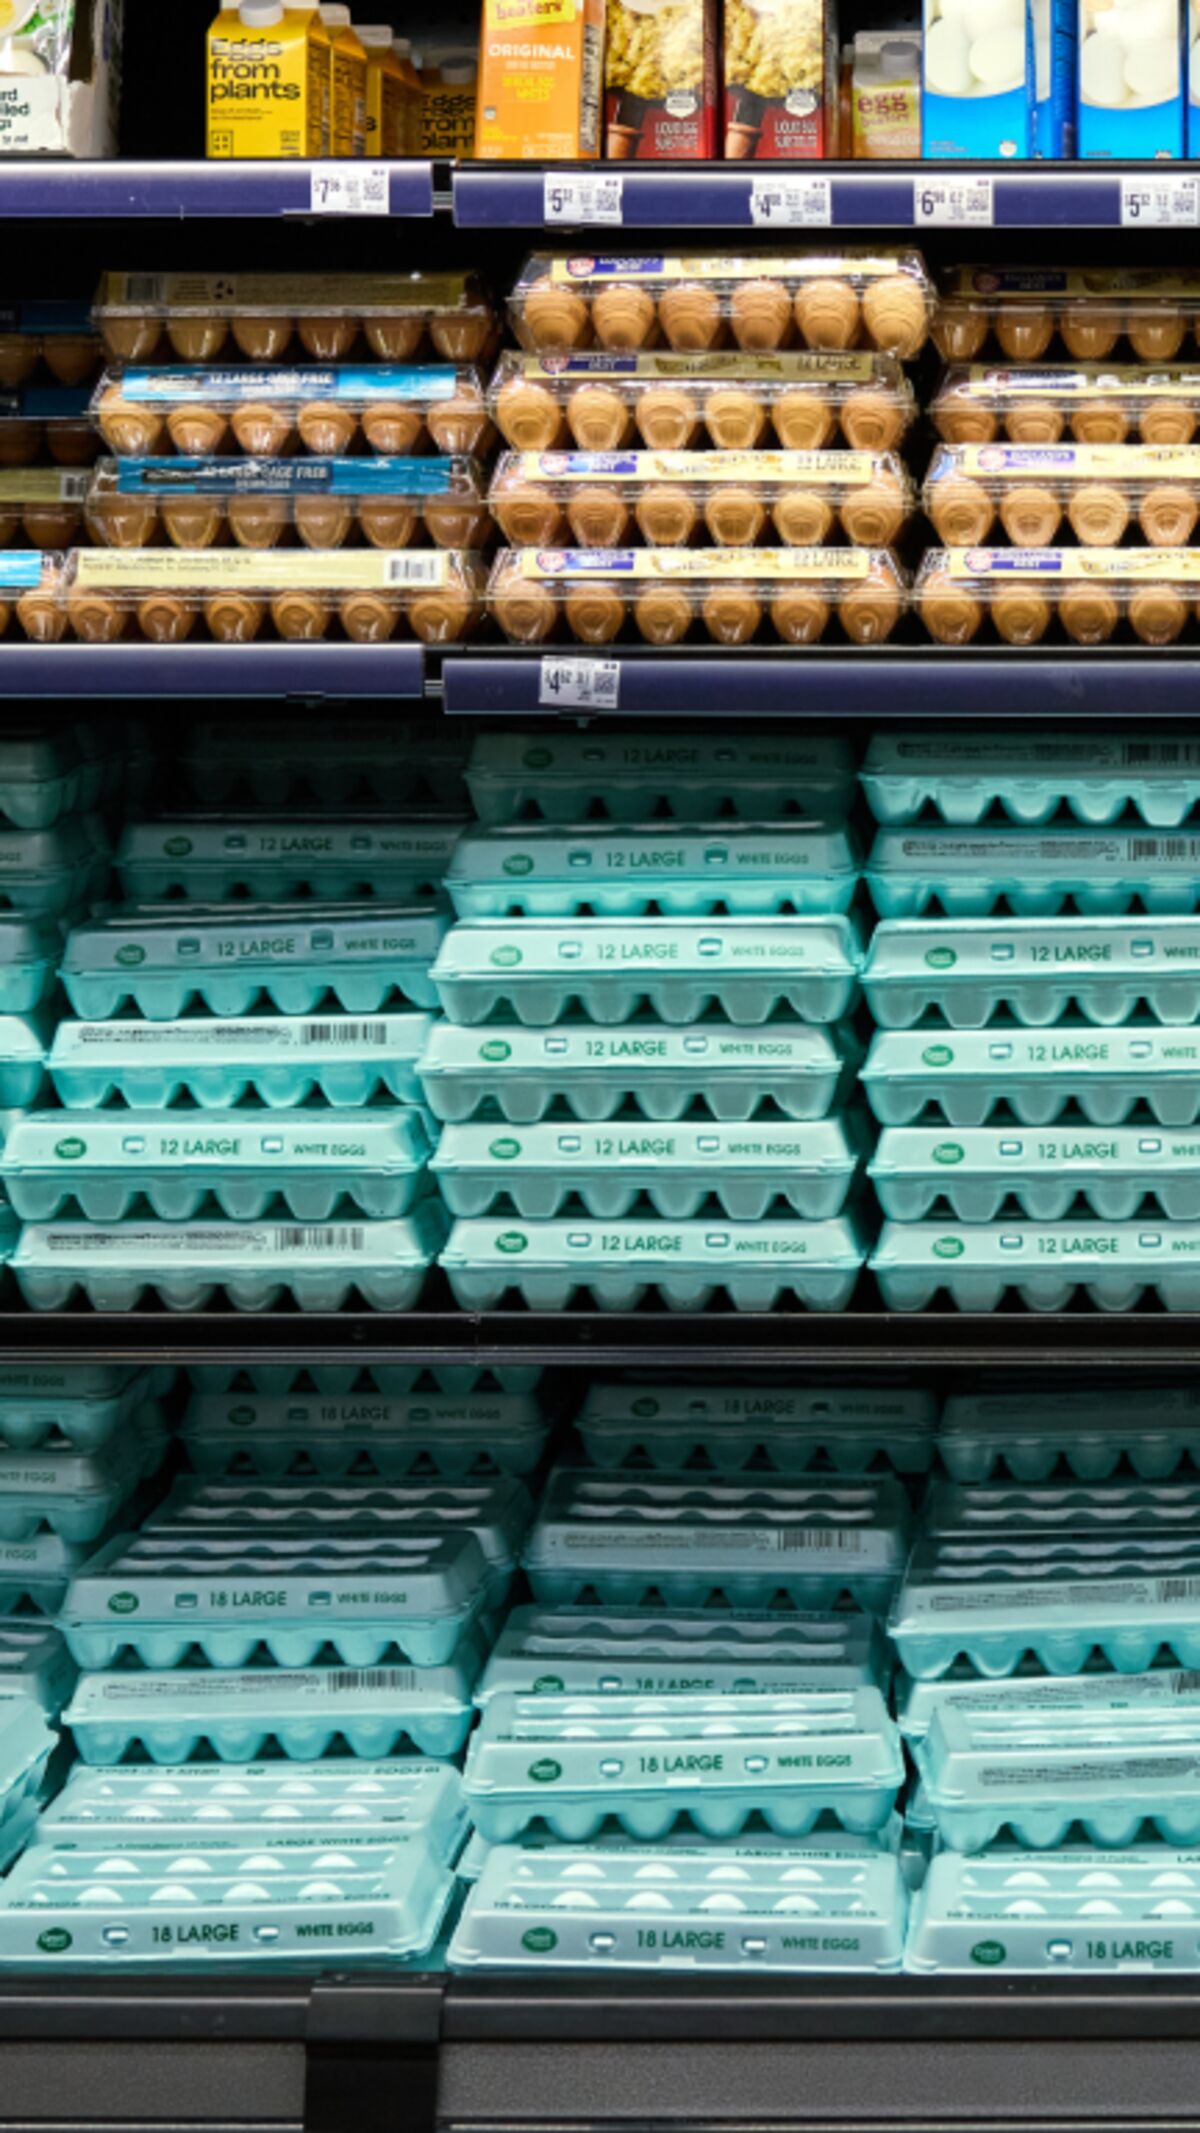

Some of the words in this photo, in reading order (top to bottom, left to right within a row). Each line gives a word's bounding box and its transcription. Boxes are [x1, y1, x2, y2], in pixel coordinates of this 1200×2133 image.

[210, 37, 283, 61] Eggs
[488, 43, 575, 60] ORIGINAL
[210, 58, 281, 79] from
[210, 80, 301, 104] plants
[857, 89, 907, 114] egg
[645, 748, 699, 764] LARGE
[259, 837, 276, 851] 12
[280, 836, 334, 851] LARGE
[606, 851, 625, 867] 12
[630, 850, 686, 867] LARGE
[217, 941, 235, 956] 12
[240, 939, 296, 956] LARGE
[597, 944, 615, 959] 12
[621, 943, 679, 959] LARGE
[1029, 945, 1049, 961] 12
[1054, 944, 1112, 961] LARGE
[586, 1040, 604, 1056] 12
[610, 1040, 667, 1056] LARGE
[1027, 1045, 1047, 1060] 12
[1051, 1044, 1109, 1060] LARGE
[160, 1139, 178, 1155] 12
[183, 1138, 242, 1155] LARGE
[595, 1139, 614, 1155] 12
[618, 1138, 676, 1155] LARGE
[1037, 1143, 1057, 1158] 12
[1061, 1142, 1119, 1158] LARGE
[600, 1235, 619, 1251] 12
[624, 1234, 683, 1251] LARGE
[1037, 1238, 1057, 1254] 12
[1061, 1237, 1119, 1254] LARGE
[340, 1406, 391, 1421] LARGE
[744, 1399, 796, 1415] LARGE
[209, 1591, 228, 1607] 18
[232, 1590, 288, 1607] LARGE
[639, 1756, 659, 1773] 18
[663, 1754, 724, 1772] LARGE
[777, 1755, 812, 1769] WHITE
[152, 1925, 171, 1943] 18
[176, 1923, 240, 1943] LARGE
[295, 1924, 334, 1938] WHITE
[336, 1922, 375, 1936] EGGS
[636, 1929, 656, 1947] 18
[661, 1930, 726, 1949] LARGE
[780, 1935, 819, 1950] WHITE
[821, 1936, 860, 1952] EGGS
[1086, 1940, 1106, 1959] 18
[1111, 1940, 1174, 1959] LARGE
